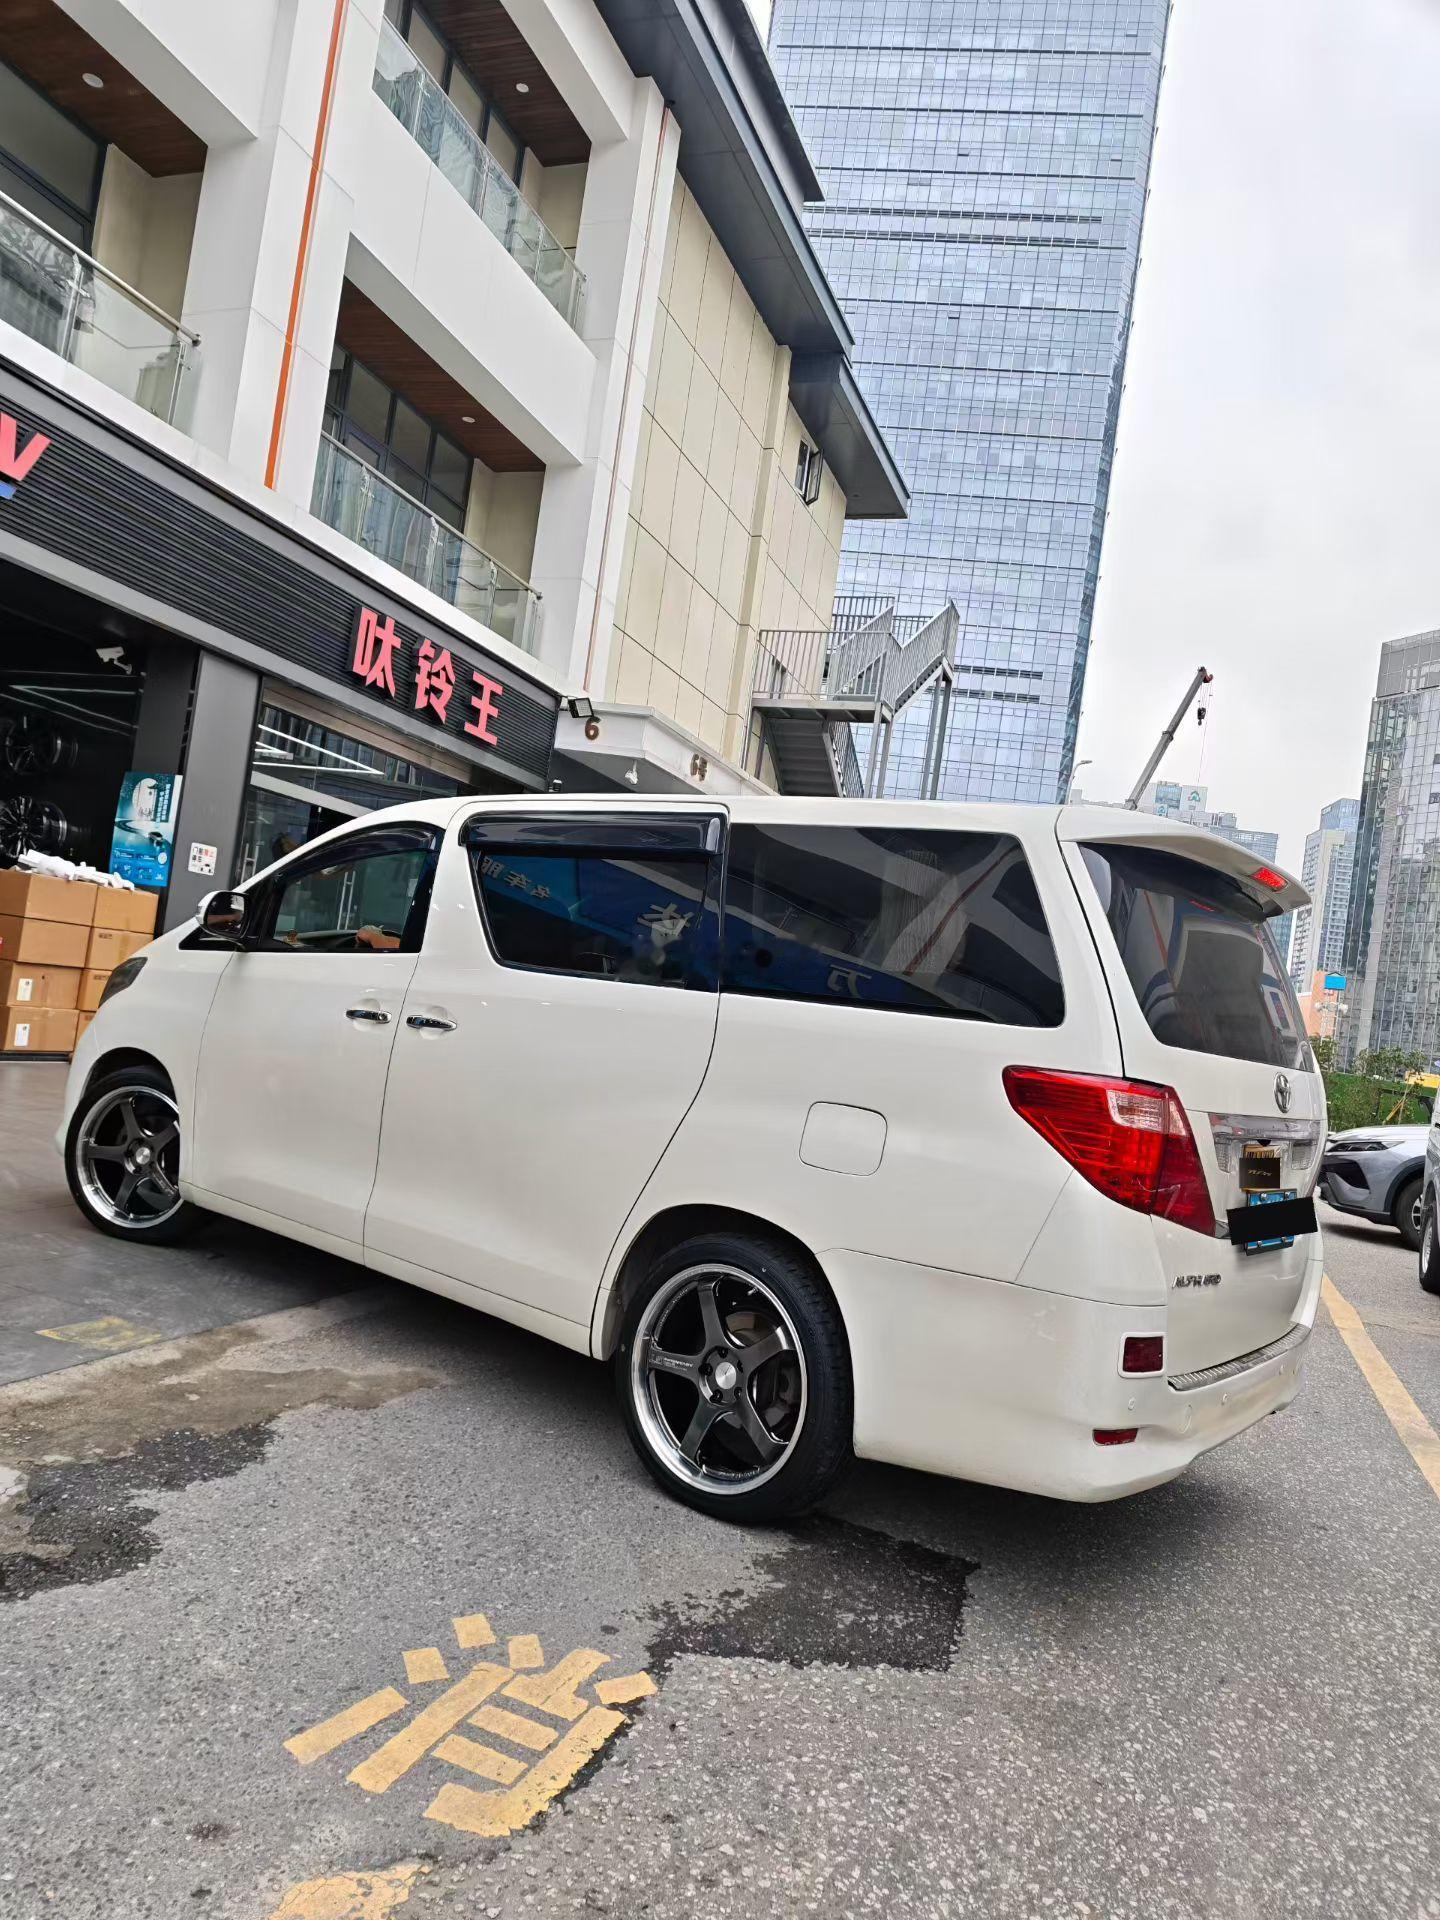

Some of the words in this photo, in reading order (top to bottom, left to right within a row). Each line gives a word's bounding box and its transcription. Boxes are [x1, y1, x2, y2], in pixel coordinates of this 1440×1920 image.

[352, 606, 503, 747] 呔铃王
[585, 716, 602, 741] 6
